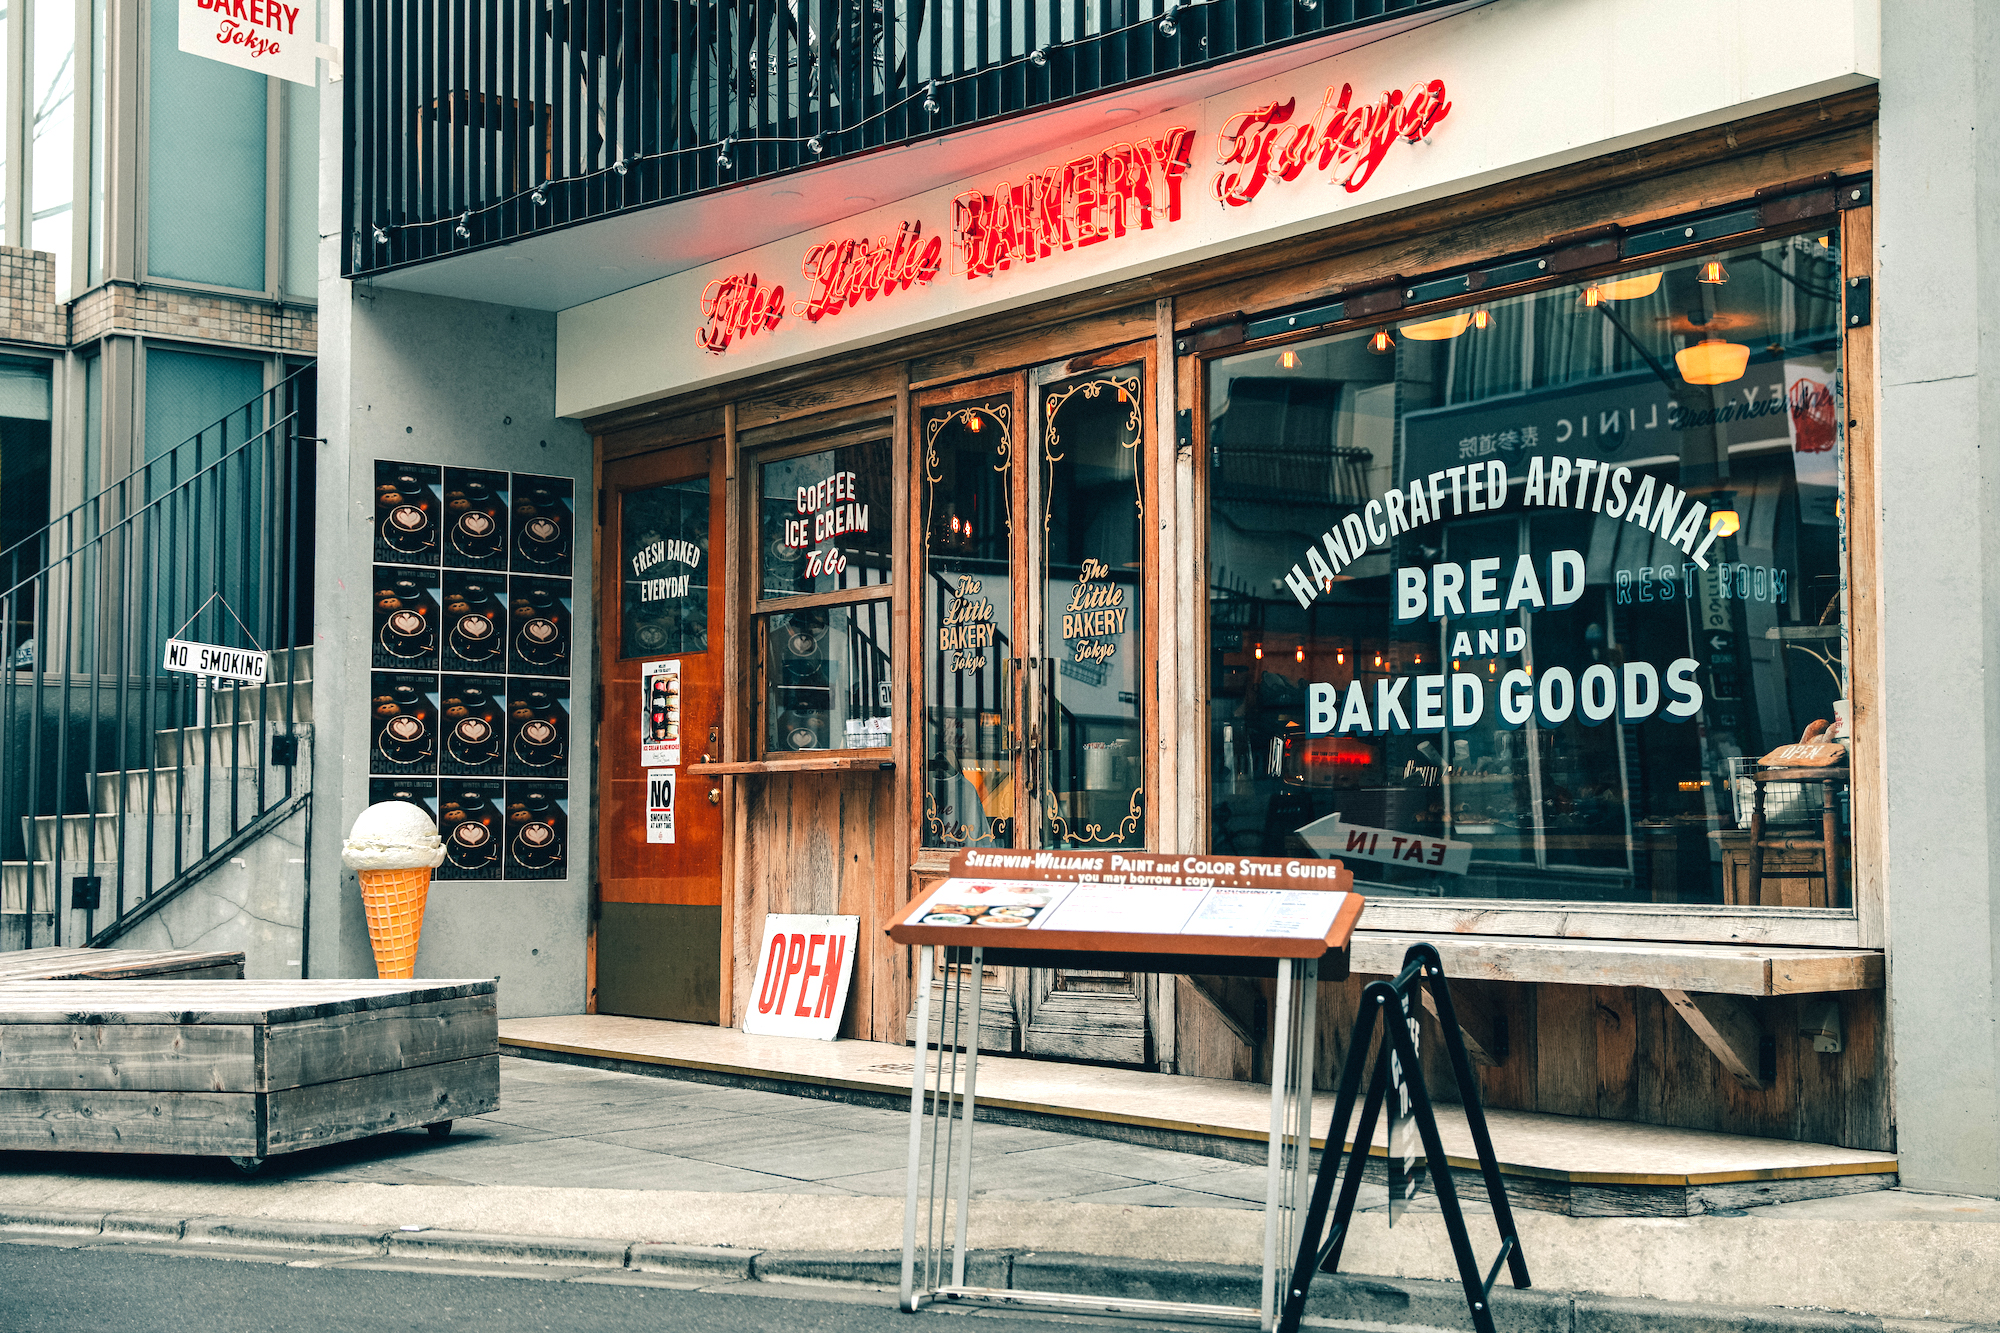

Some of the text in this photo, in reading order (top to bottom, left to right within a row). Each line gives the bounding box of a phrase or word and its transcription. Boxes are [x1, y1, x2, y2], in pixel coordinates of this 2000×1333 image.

[216, 19, 281, 58] Tokyo
[695, 79, 1452, 355] The Little BAKERY Tokyo
[1671, 398, 1735, 431] Bread
[797, 471, 856, 515] COFFEE
[785, 503, 869, 549] ICE CREAM
[1284, 456, 1726, 610] HANDCRAFTED ARTISANAL
[374, 549, 440, 565] CHOCOLATE
[632, 539, 701, 577] FRESH BAKED
[1079, 558, 1109, 584] The
[641, 574, 690, 602] EVERYDAY
[954, 574, 982, 598] The
[1066, 581, 1123, 612] Little
[1395, 549, 1586, 624] BREAD
[1615, 562, 1698, 605] REST
[1719, 562, 1788, 604] ROOM
[943, 596, 994, 626] Little
[1063, 607, 1127, 640] BAKERY
[940, 622, 997, 650] BAKERY
[1452, 626, 1528, 658] AND
[169, 644, 263, 677] NO SMOKING
[373, 654, 439, 669] CHOCOLATE
[950, 651, 986, 676] Tokyo
[1074, 640, 1116, 665] Tokyo
[1307, 657, 1704, 736] BAKED GOODS
[1780, 744, 1825, 760] OPEN
[371, 761, 437, 774] CHOCOLATE
[440, 762, 504, 775] CHOCOLATE
[651, 780, 671, 807] NO
[650, 814, 672, 822] SMOKING
[438, 867, 502, 879] CHOCOLATE
[1078, 873, 1100, 884] you
[1103, 874, 1127, 885] may
[1130, 872, 1172, 885] borrow
[1175, 876, 1183, 885] a
[1185, 876, 1215, 888] copy
[1111, 855, 1155, 872] PAINT
[1156, 860, 1180, 874] and
[1183, 857, 1236, 876] COLOR
[1240, 859, 1282, 877] STYLE
[1286, 860, 1337, 879] GUIDE
[758, 933, 846, 1019] OPEN
